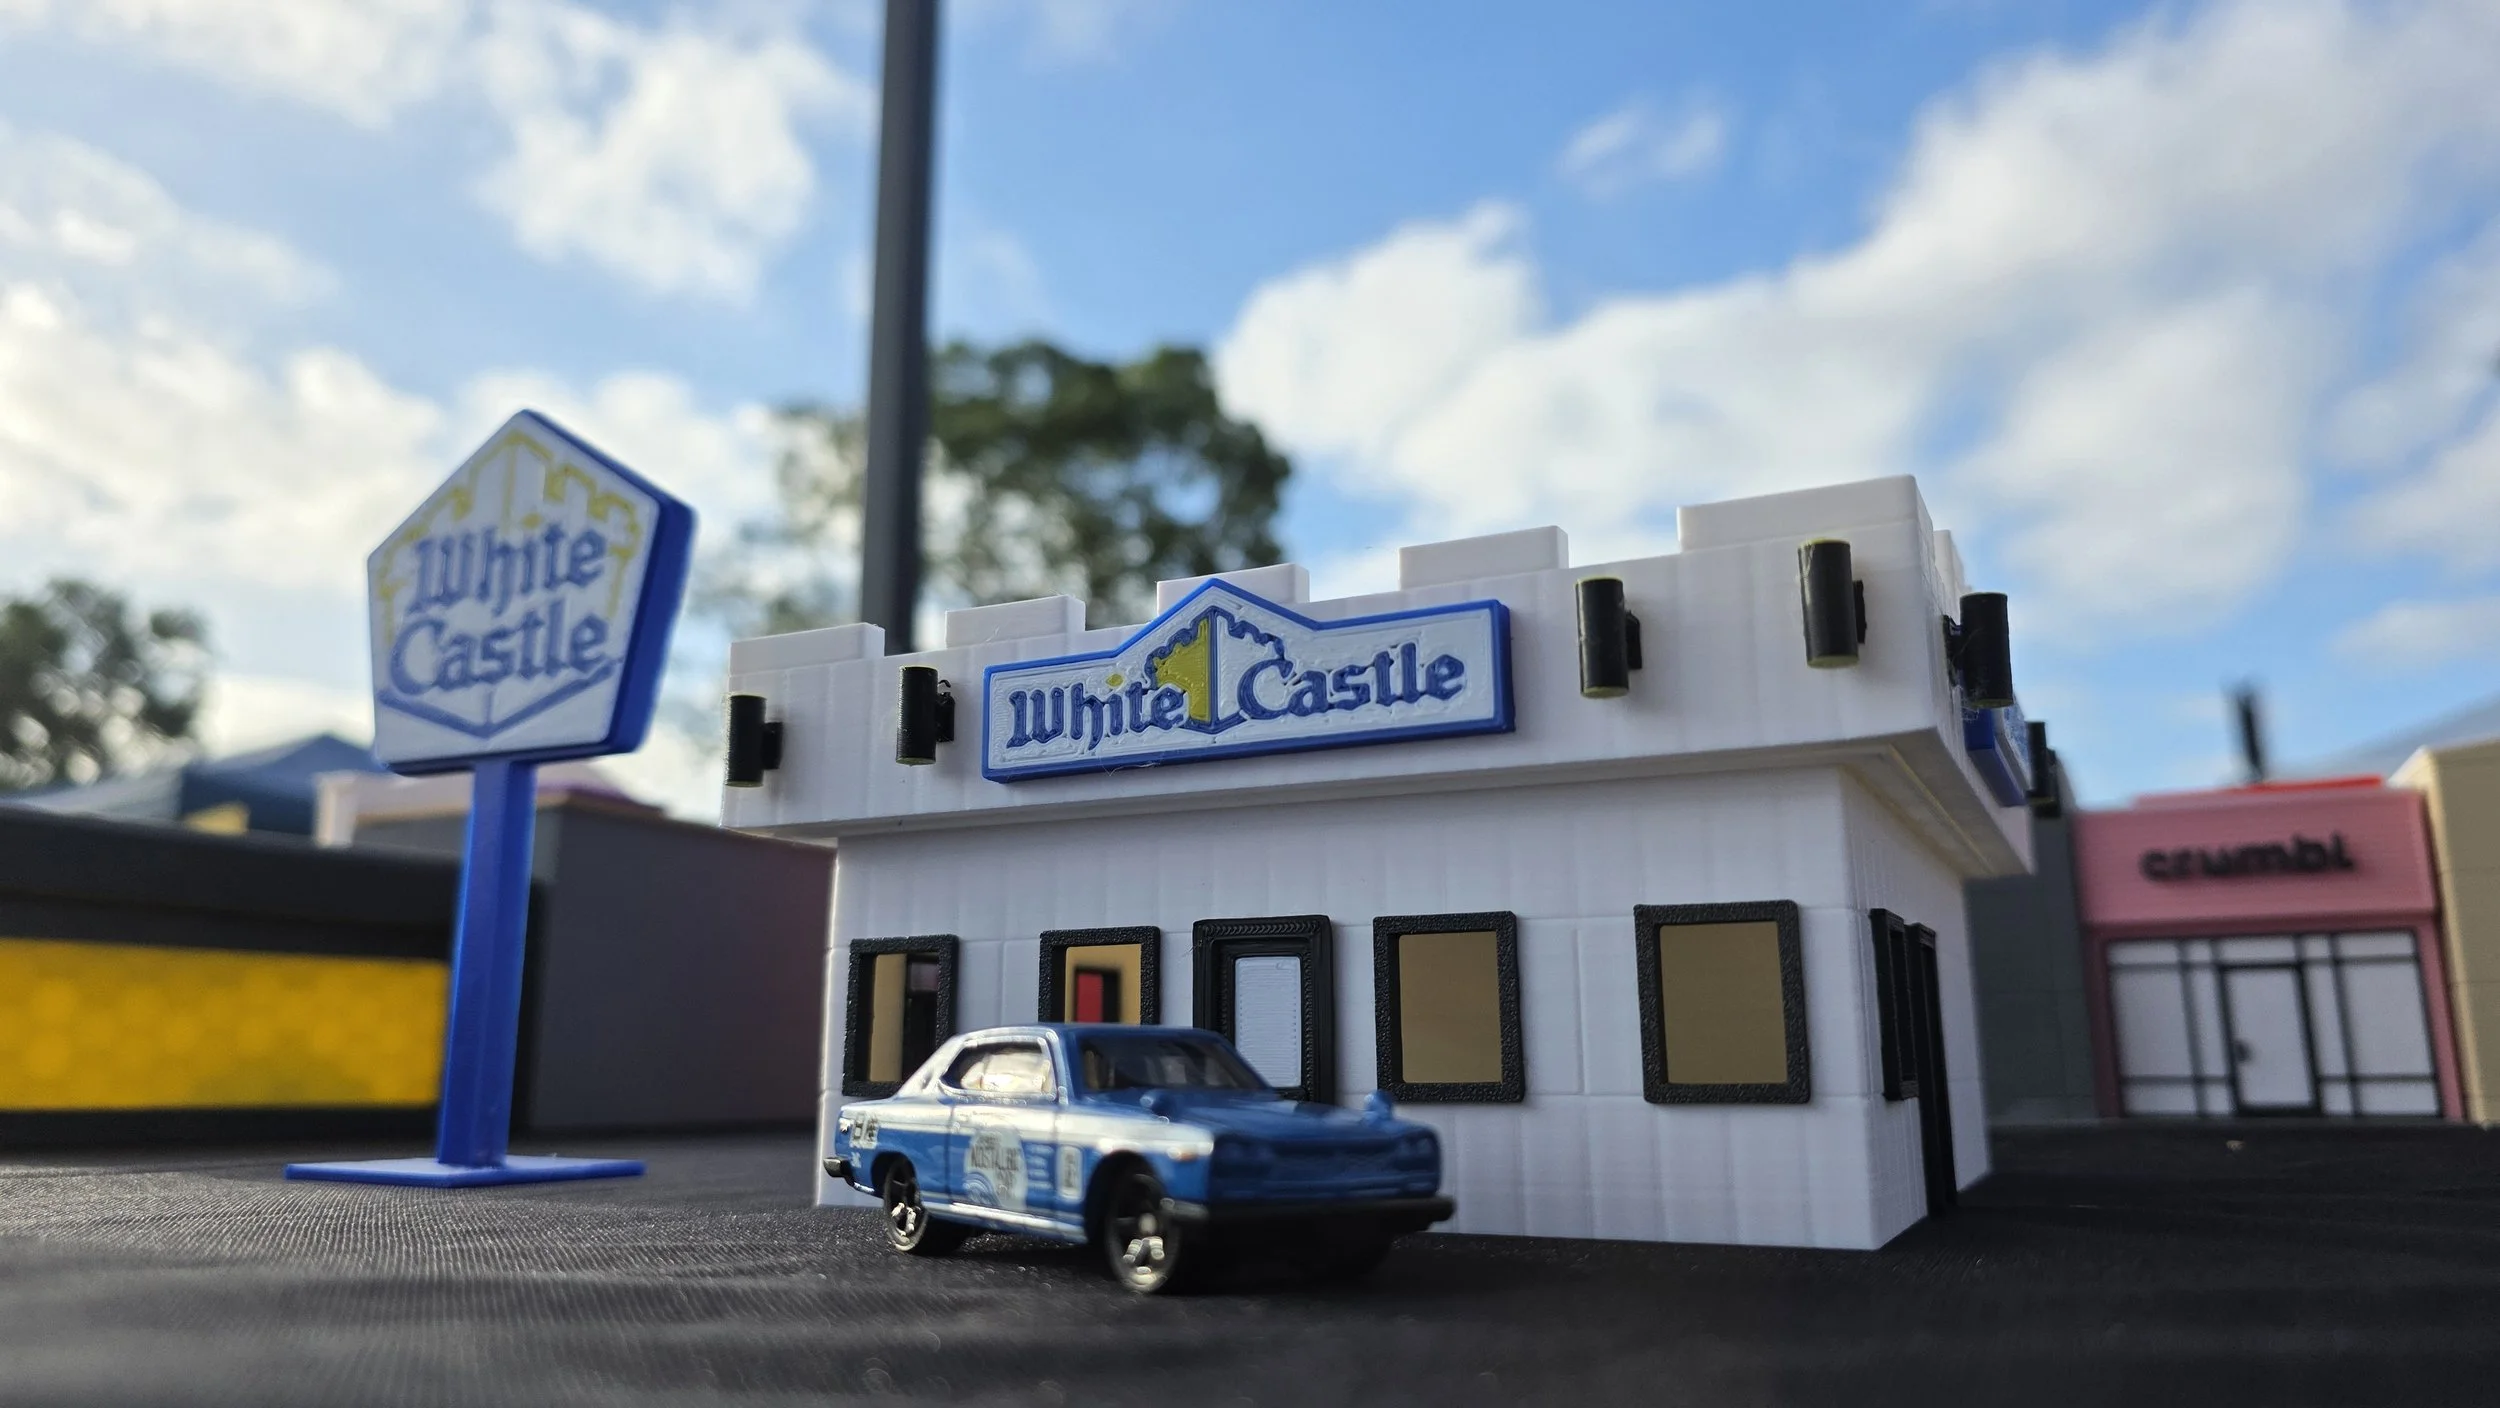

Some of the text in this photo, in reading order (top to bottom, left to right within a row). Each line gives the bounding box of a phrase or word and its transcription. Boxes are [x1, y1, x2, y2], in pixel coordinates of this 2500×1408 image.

[407, 518, 606, 616] White
[391, 599, 608, 695] Castle
[1006, 643, 1465, 750] White Castle
